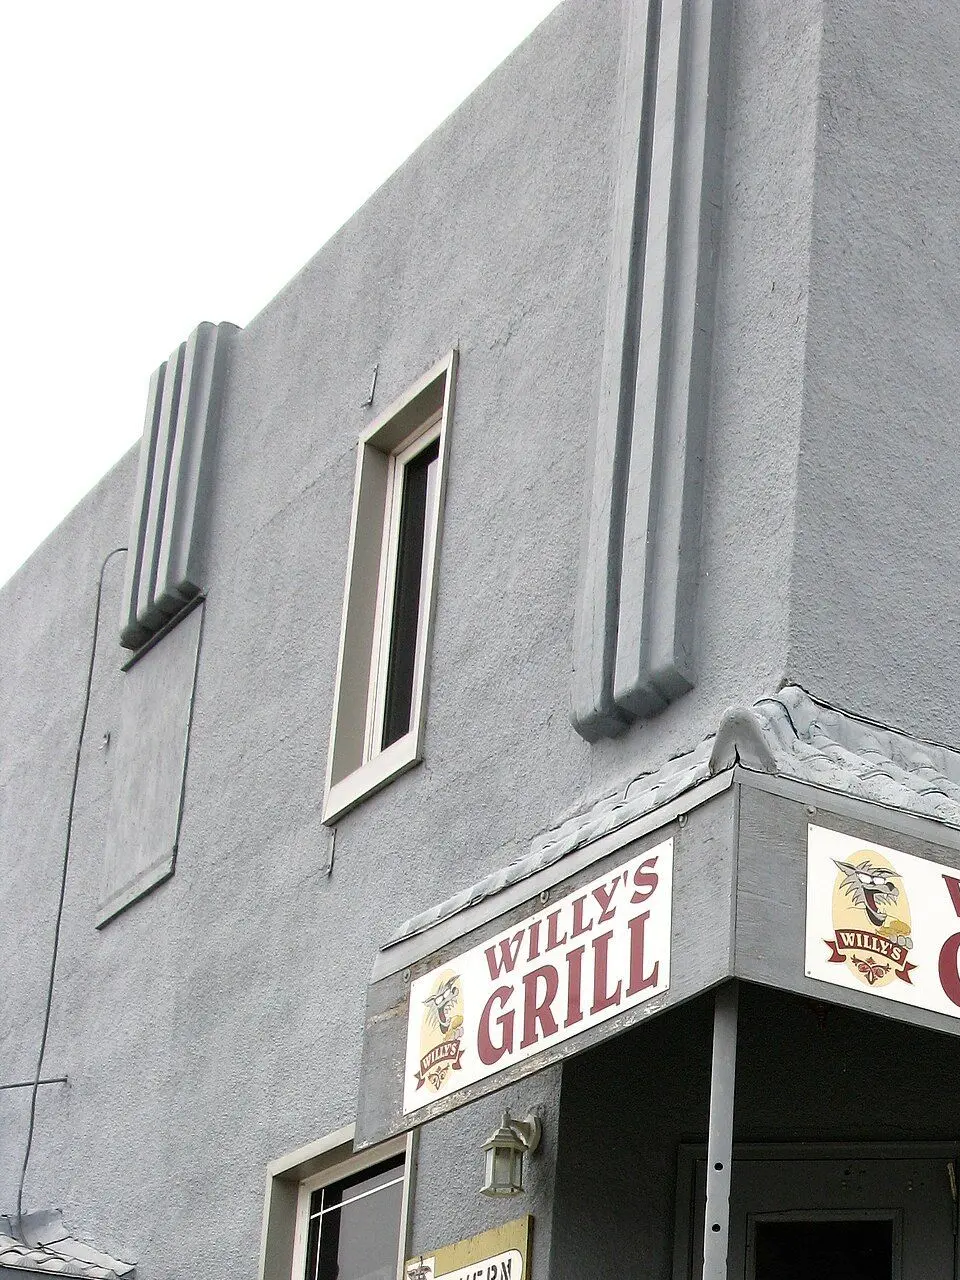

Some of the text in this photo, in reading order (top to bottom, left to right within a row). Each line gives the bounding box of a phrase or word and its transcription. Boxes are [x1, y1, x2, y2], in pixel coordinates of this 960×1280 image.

[484, 856, 659, 981] WILLY'S
[840, 932, 902, 961] WILLY'S
[477, 910, 660, 1066] GRILL
